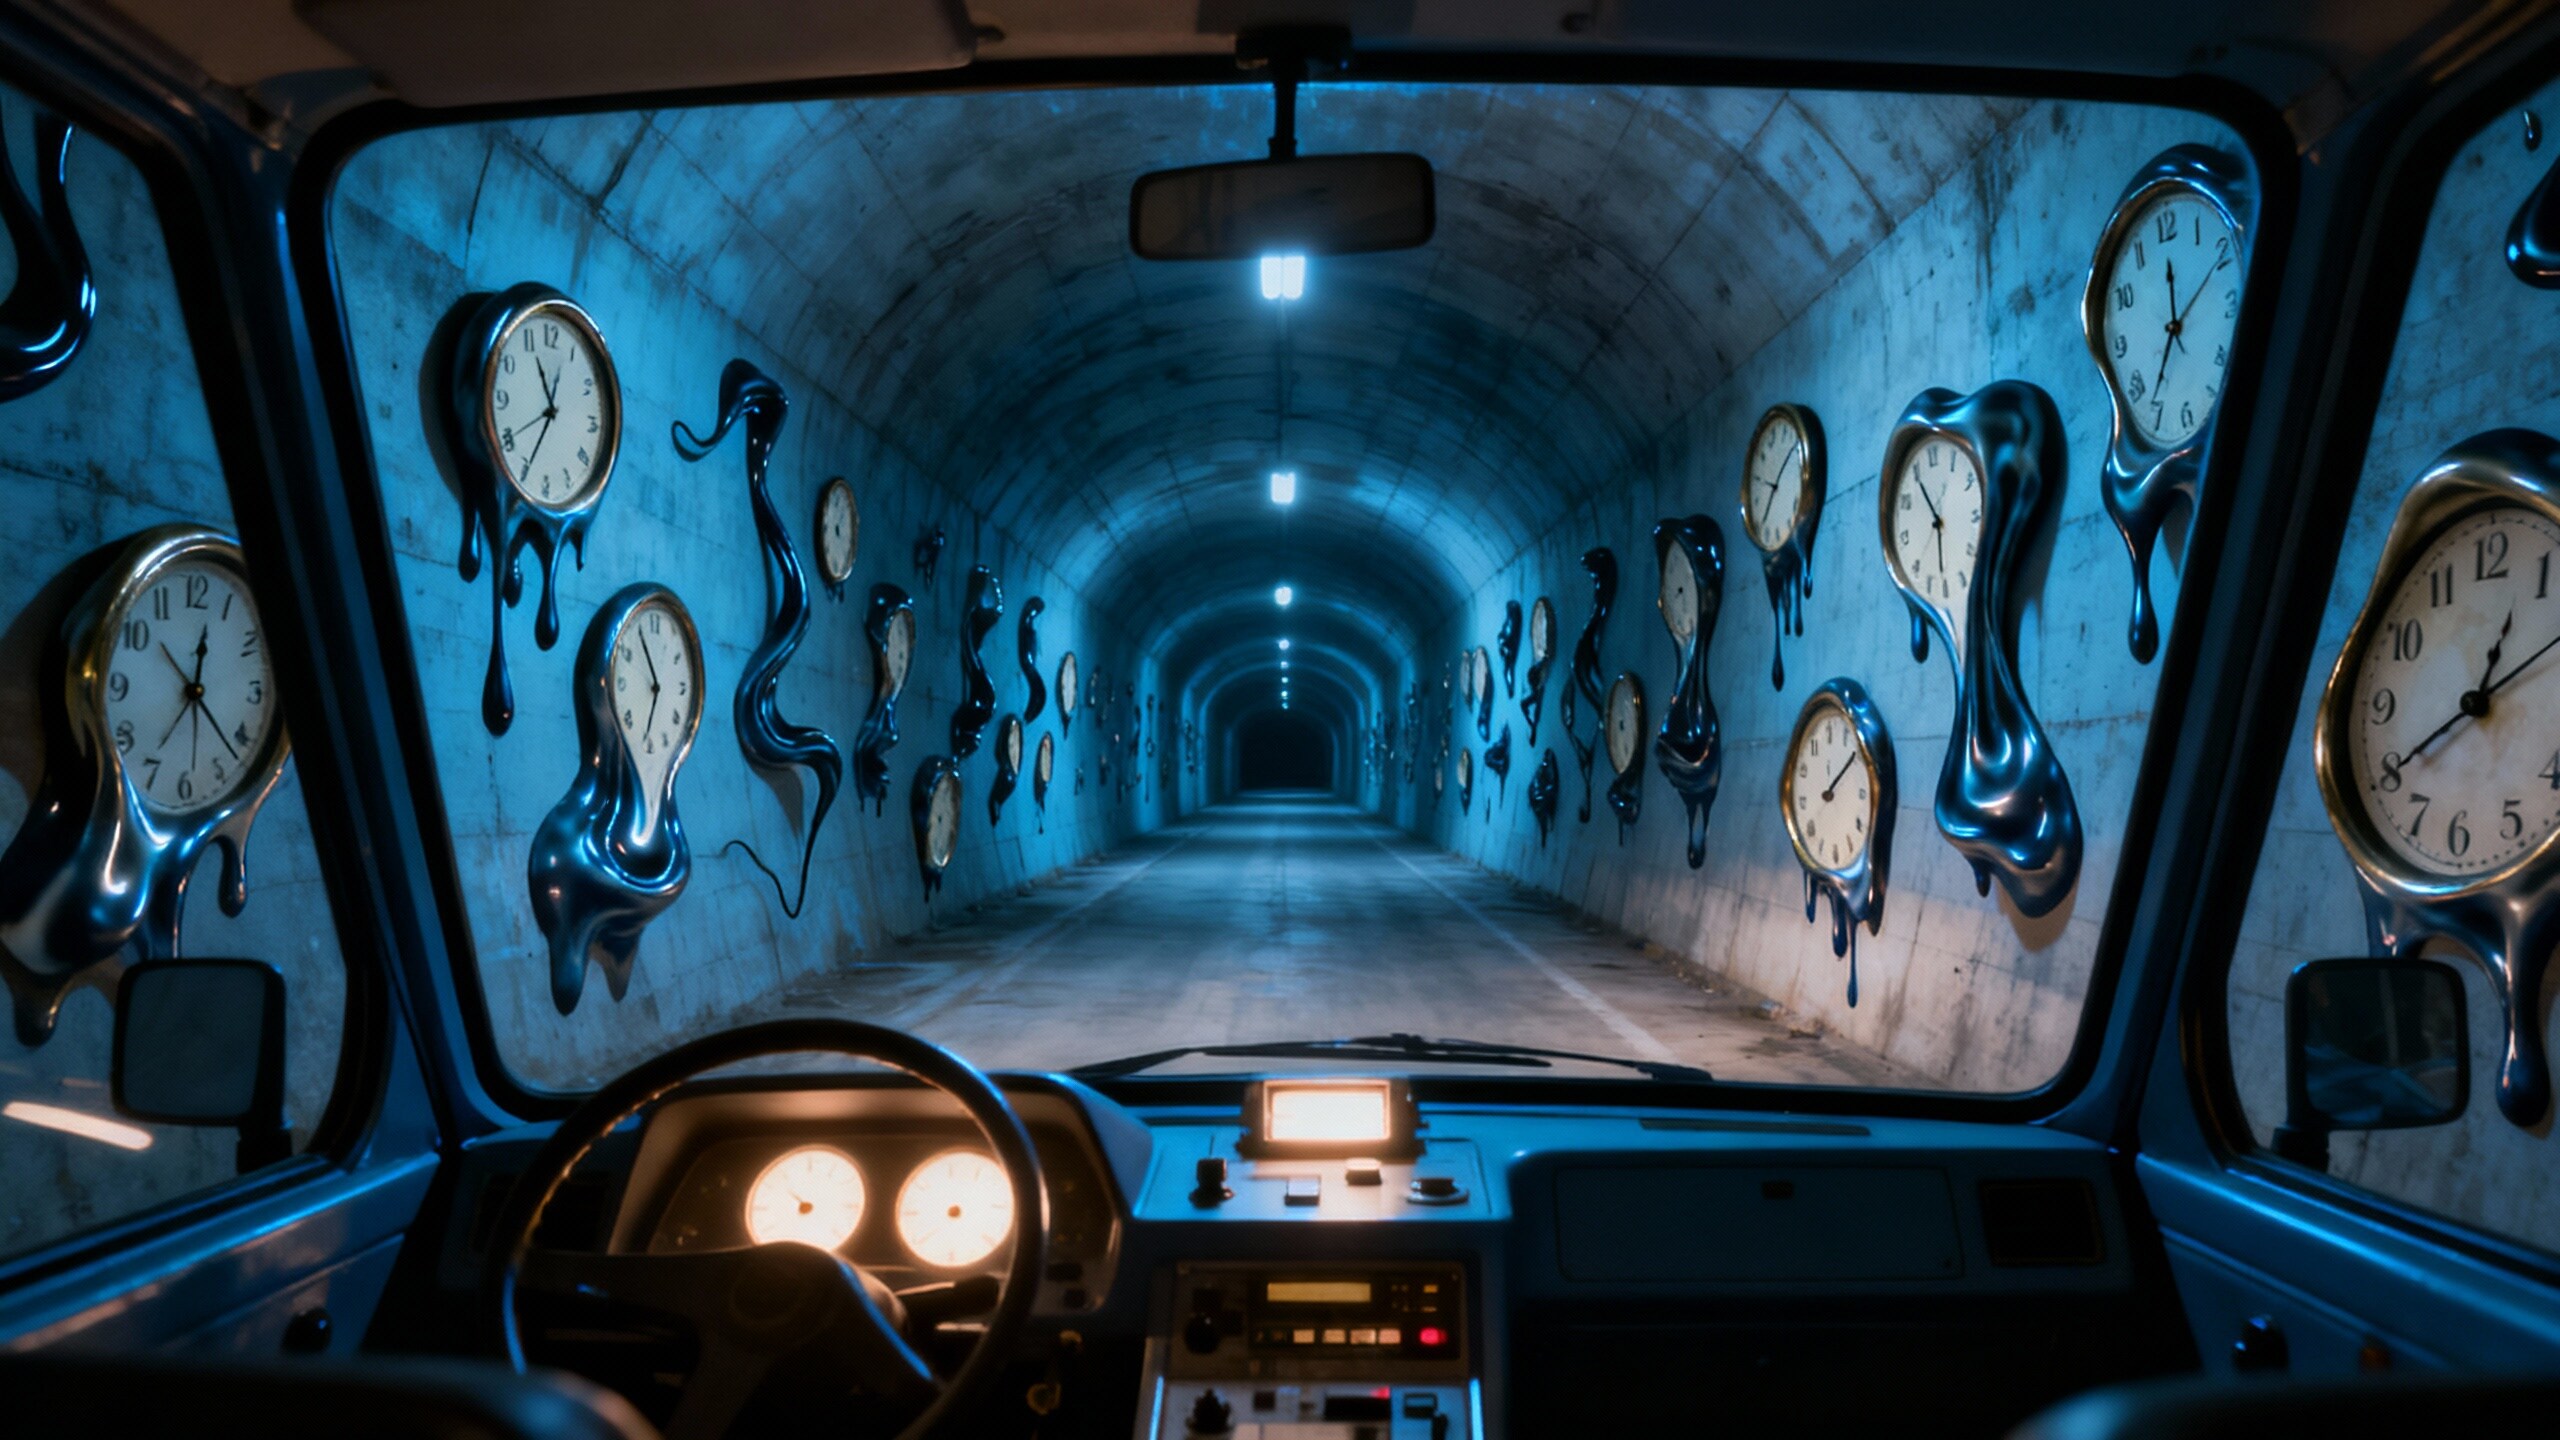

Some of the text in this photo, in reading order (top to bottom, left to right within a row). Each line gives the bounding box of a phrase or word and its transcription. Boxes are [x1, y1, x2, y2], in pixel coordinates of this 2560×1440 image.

[2155, 210, 2177, 244] 12
[2194, 216, 2200, 246] 1
[2134, 240, 2146, 271] 11
[2215, 236, 2233, 271] 2
[2115, 283, 2134, 311] 10
[523, 328, 535, 352] 11
[543, 323, 559, 350] 12
[2114, 335, 2127, 359] 9
[497, 389, 509, 411] 9
[2151, 400, 2164, 431] 7
[2474, 531, 2508, 582] 12
[2430, 563, 2454, 608] 11
[2534, 550, 2550, 599] 1
[154, 588, 171, 620] 11
[186, 574, 208, 610] 12
[222, 593, 233, 620] 1
[124, 620, 149, 651] 10
[2388, 618, 2424, 661] 10
[110, 673, 129, 702] 9
[2372, 688, 2396, 725] 9
[143, 758, 161, 791] 7
[177, 771, 193, 800] 6
[2380, 751, 2402, 792] 8
[2538, 750, 2560, 790] 4
[2408, 793, 2431, 837] 7
[2499, 800, 2523, 839] 5
[2447, 810, 2471, 857] 6
